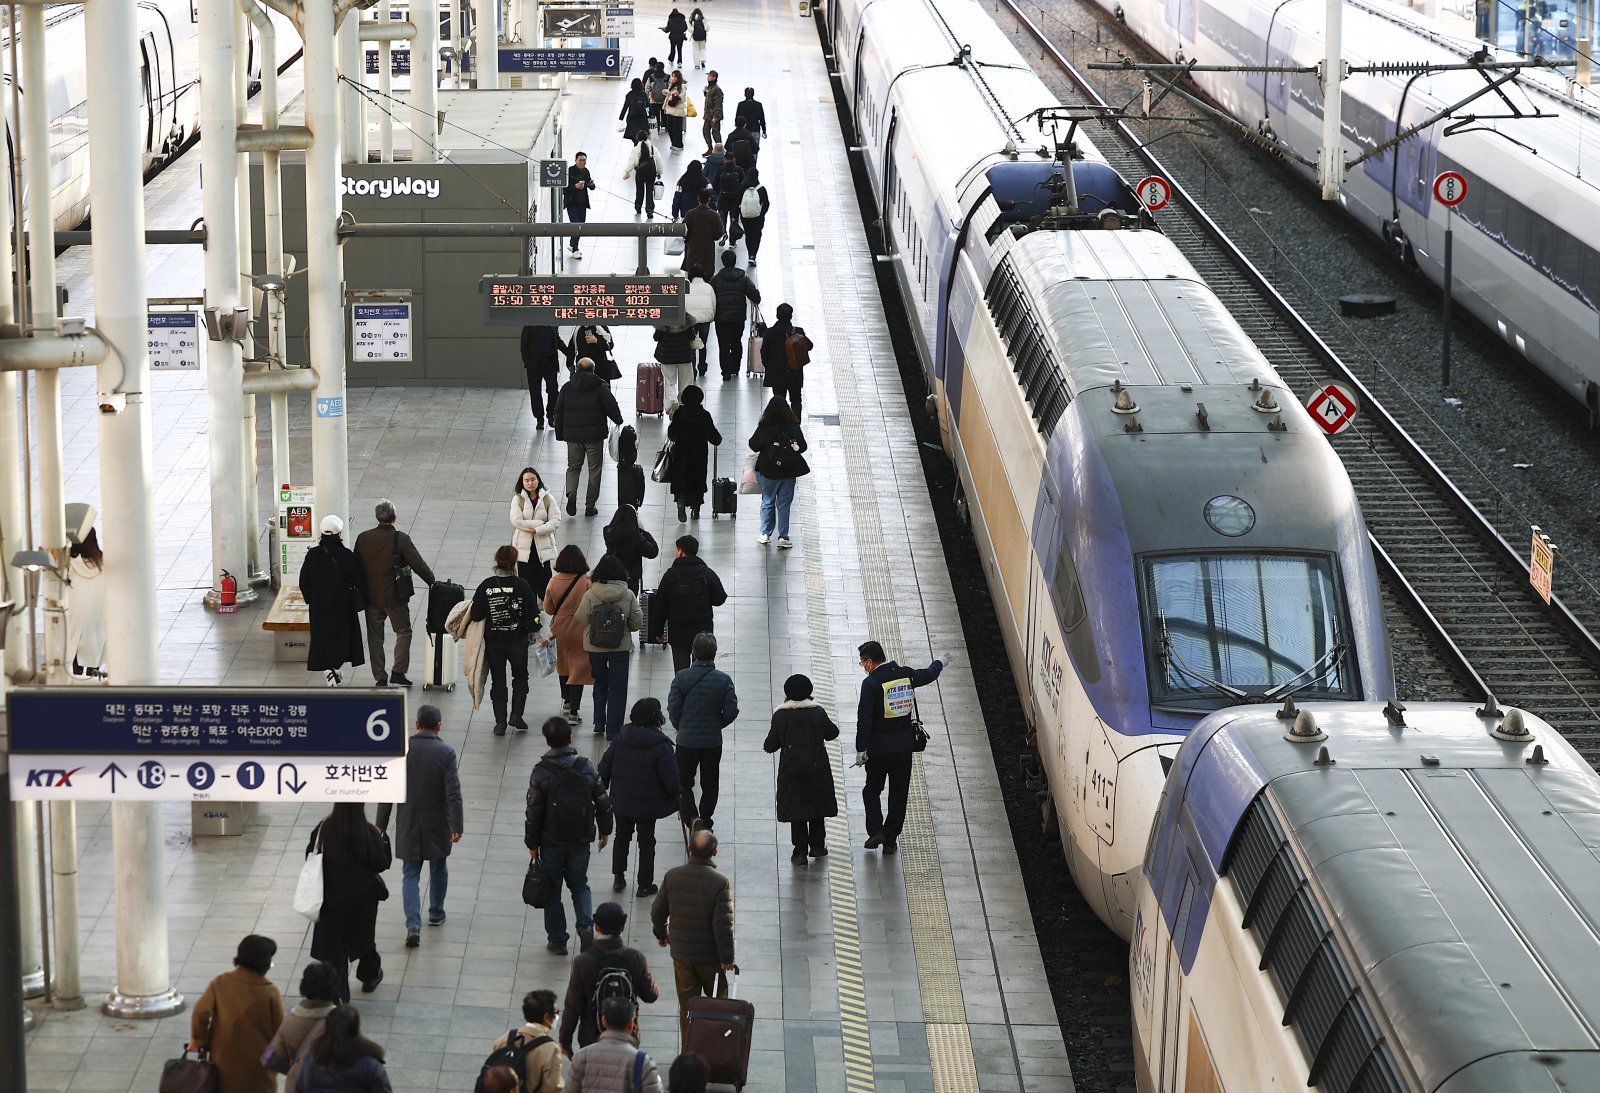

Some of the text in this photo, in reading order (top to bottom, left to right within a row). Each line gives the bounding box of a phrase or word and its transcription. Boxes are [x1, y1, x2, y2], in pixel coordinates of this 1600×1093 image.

[606, 55, 615, 67] 6
[1150, 182, 1157, 193] 8
[1447, 178, 1454, 188] 8
[1150, 195, 1157, 205] 6
[1447, 190, 1454, 200] 6
[493, 285, 678, 294] 출발시간 도착역 열차종류 열차번호 방향
[494, 295, 649, 306] 15:50 포항 KTX-산천 4033
[1324, 400, 1339, 416] A
[106, 704, 307, 716] 대전 동대구 부산 포항 진주 마산 강릉
[132, 725, 307, 737] 익산 광주송정 목포 여수EXPO 방면
[366, 709, 390, 741] 6
[26, 764, 388, 787] KTX 18 9 1 호차번호
[1091, 769, 1106, 797] 411
